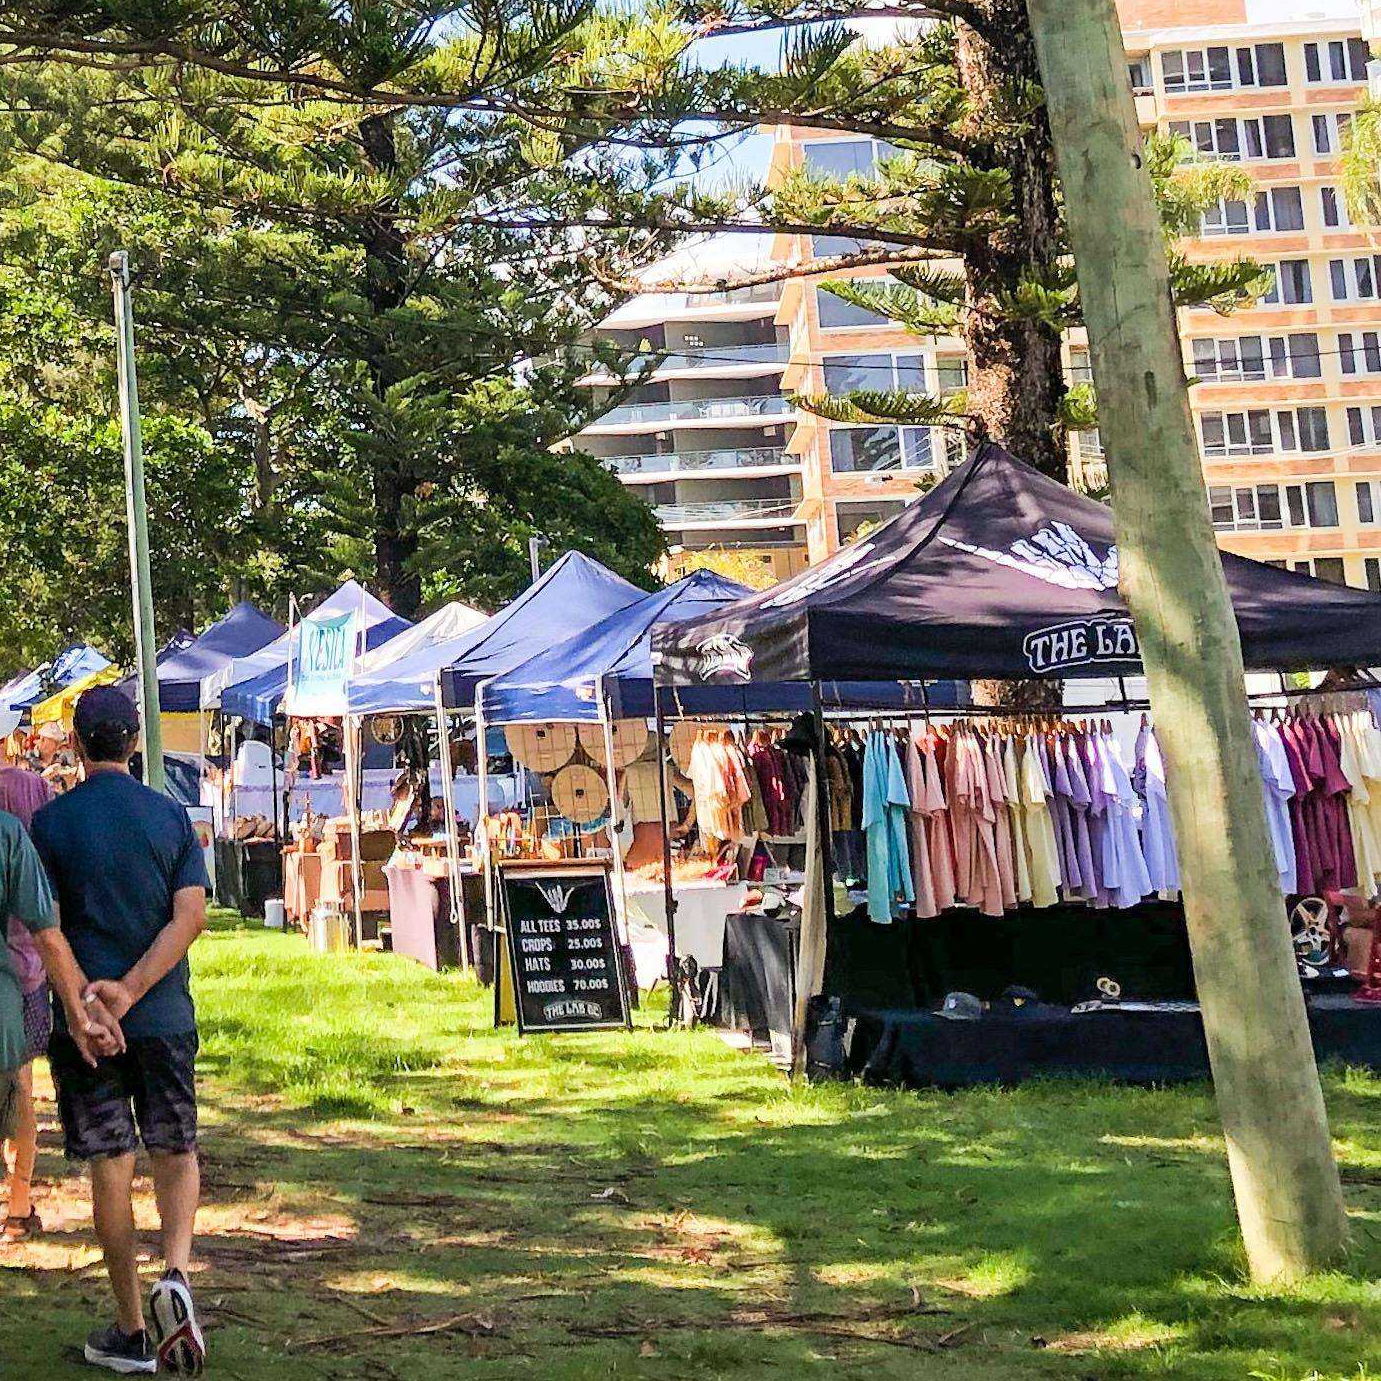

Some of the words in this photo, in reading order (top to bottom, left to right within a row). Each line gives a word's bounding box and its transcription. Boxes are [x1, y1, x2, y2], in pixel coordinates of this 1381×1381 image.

[1030, 627, 1087, 667] THE
[1096, 624, 1137, 655] LA
[520, 920, 537, 934] ALL
[538, 920, 561, 933] TEES
[566, 918, 602, 931] 35.00$
[522, 938, 553, 953] CROPS
[567, 938, 603, 950] 25.00$
[524, 957, 551, 972] HATS
[570, 958, 606, 970] 30.00$
[526, 979, 566, 994] HOODIES
[572, 978, 609, 991] 70.00$
[546, 1004, 565, 1019] THE
